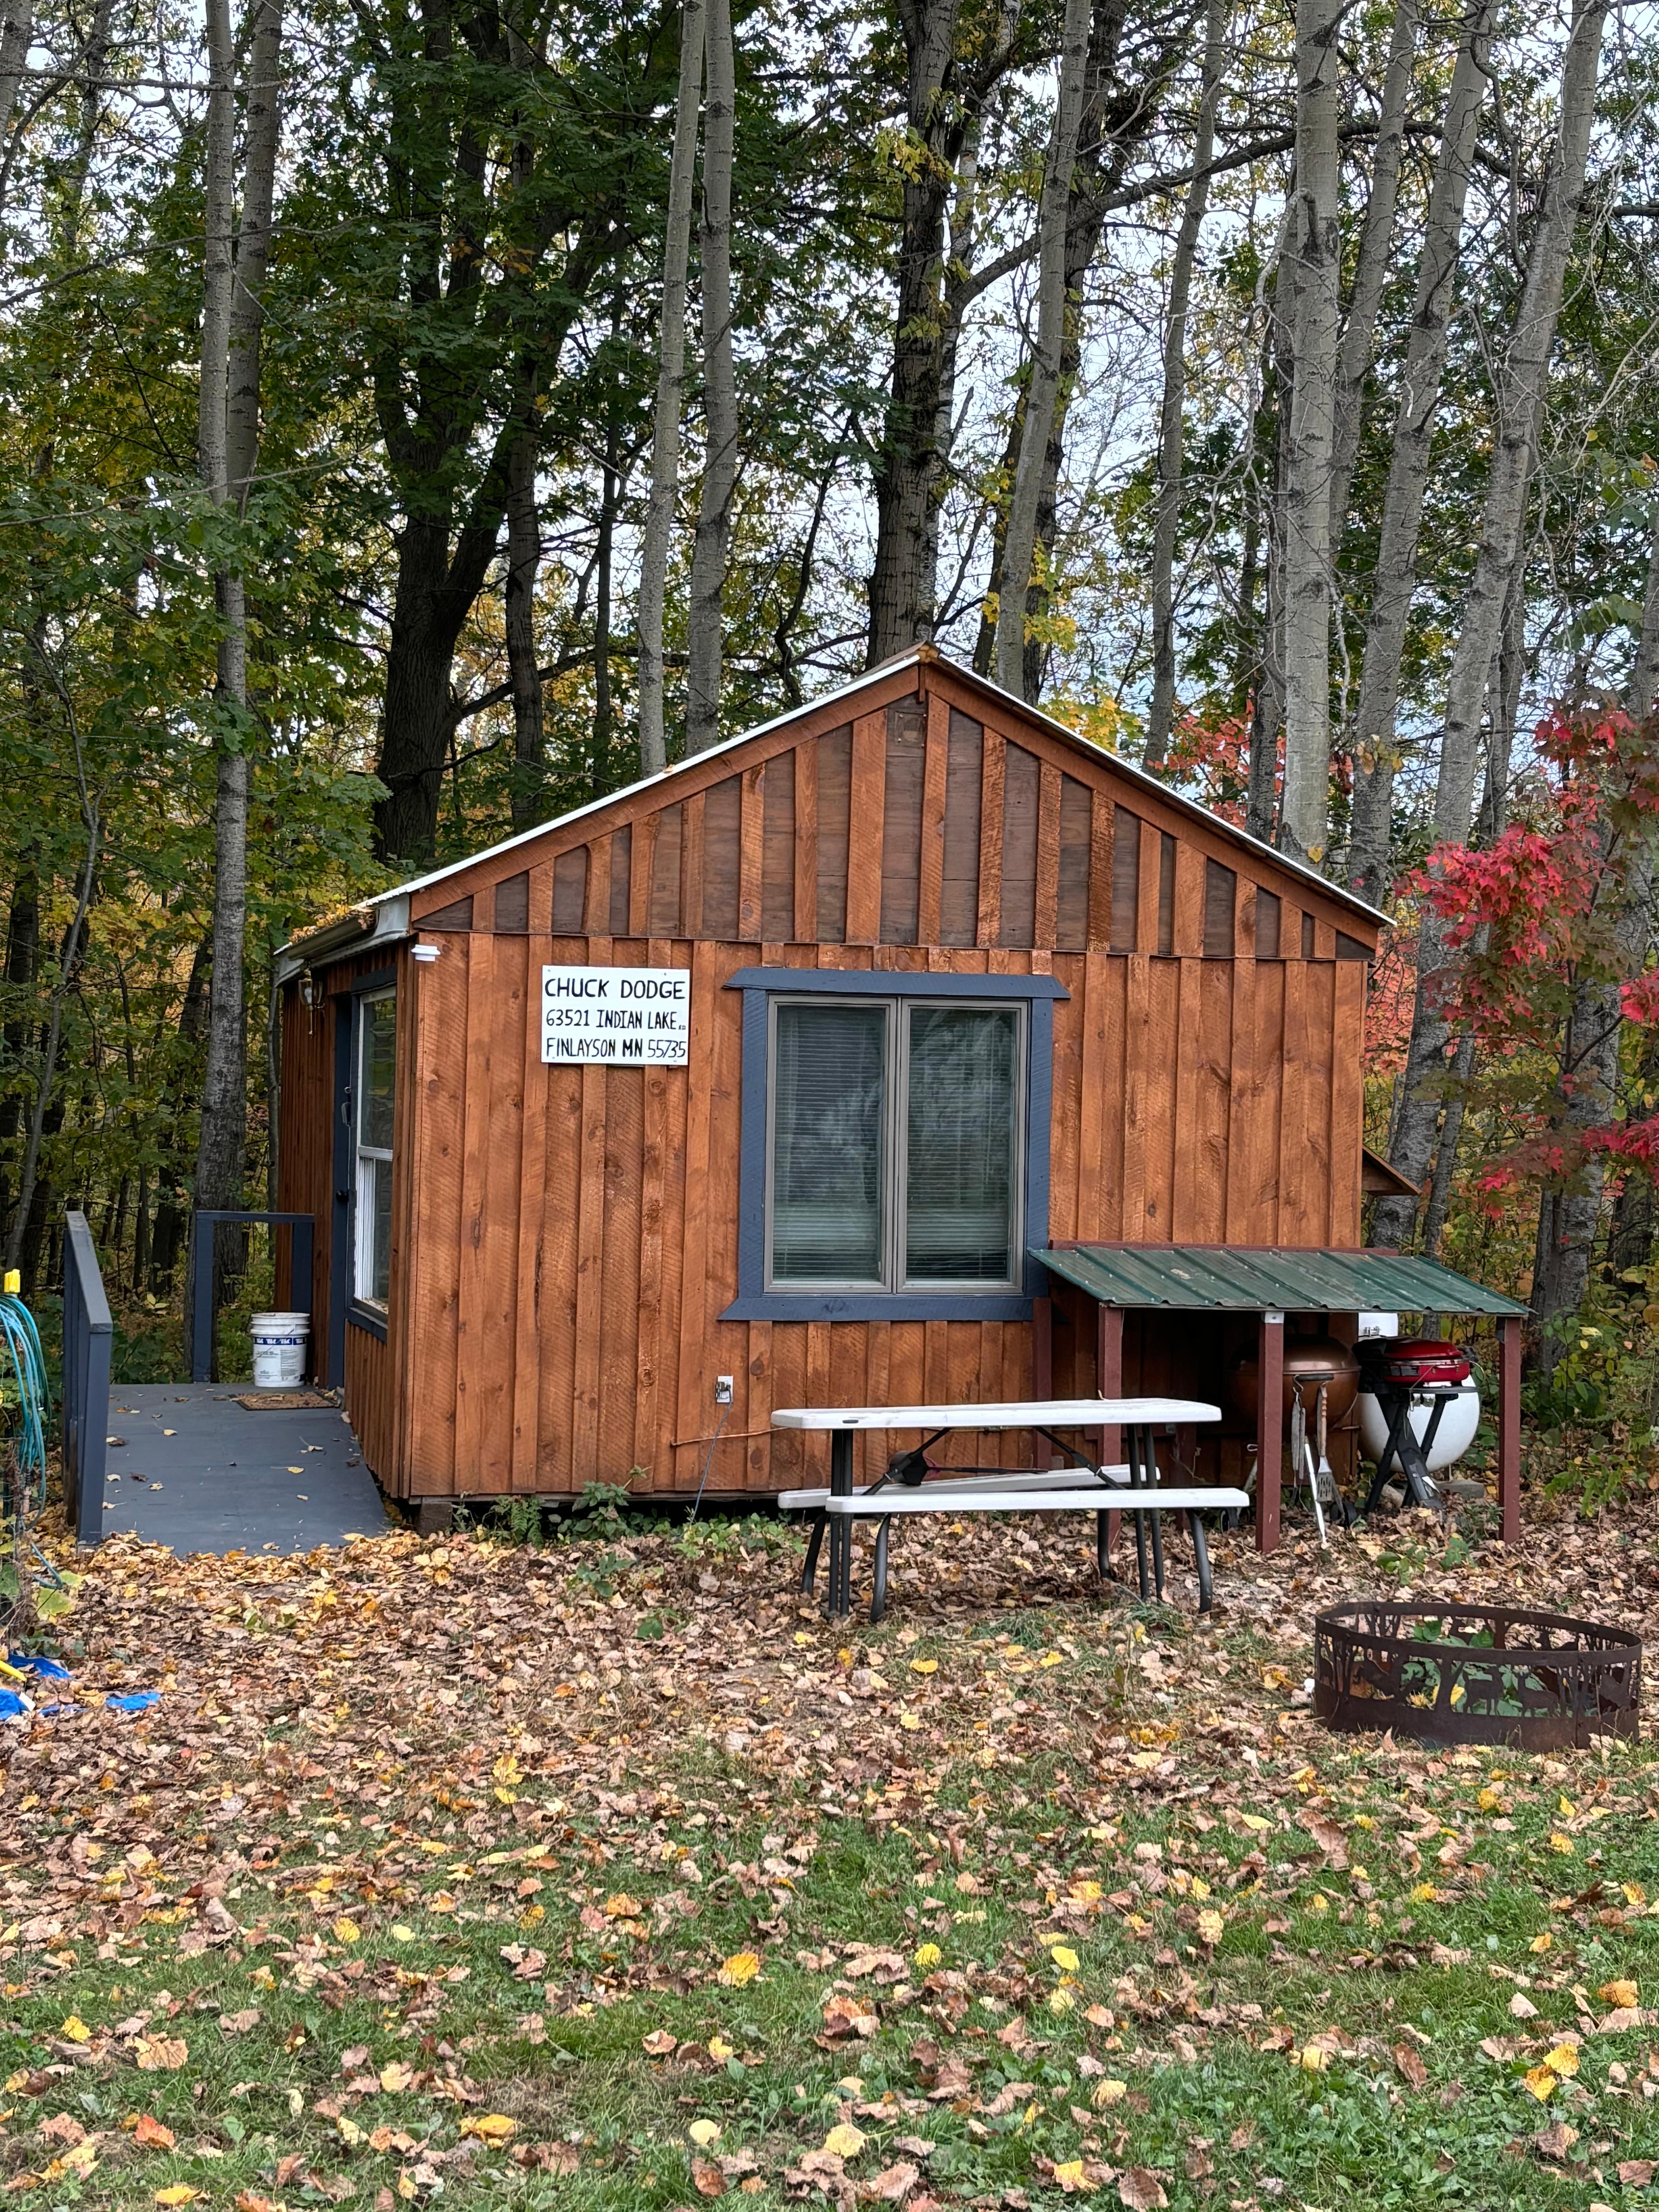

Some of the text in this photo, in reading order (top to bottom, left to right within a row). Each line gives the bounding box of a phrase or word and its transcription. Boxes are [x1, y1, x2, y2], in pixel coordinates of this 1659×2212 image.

[545, 978, 686, 999] CHUCK DODGE
[546, 1009, 590, 1026] 63521
[596, 1010, 642, 1029] INDIAN
[648, 1011, 677, 1030] LAKE
[547, 1037, 686, 1058] FINLAYSON MN 55735
